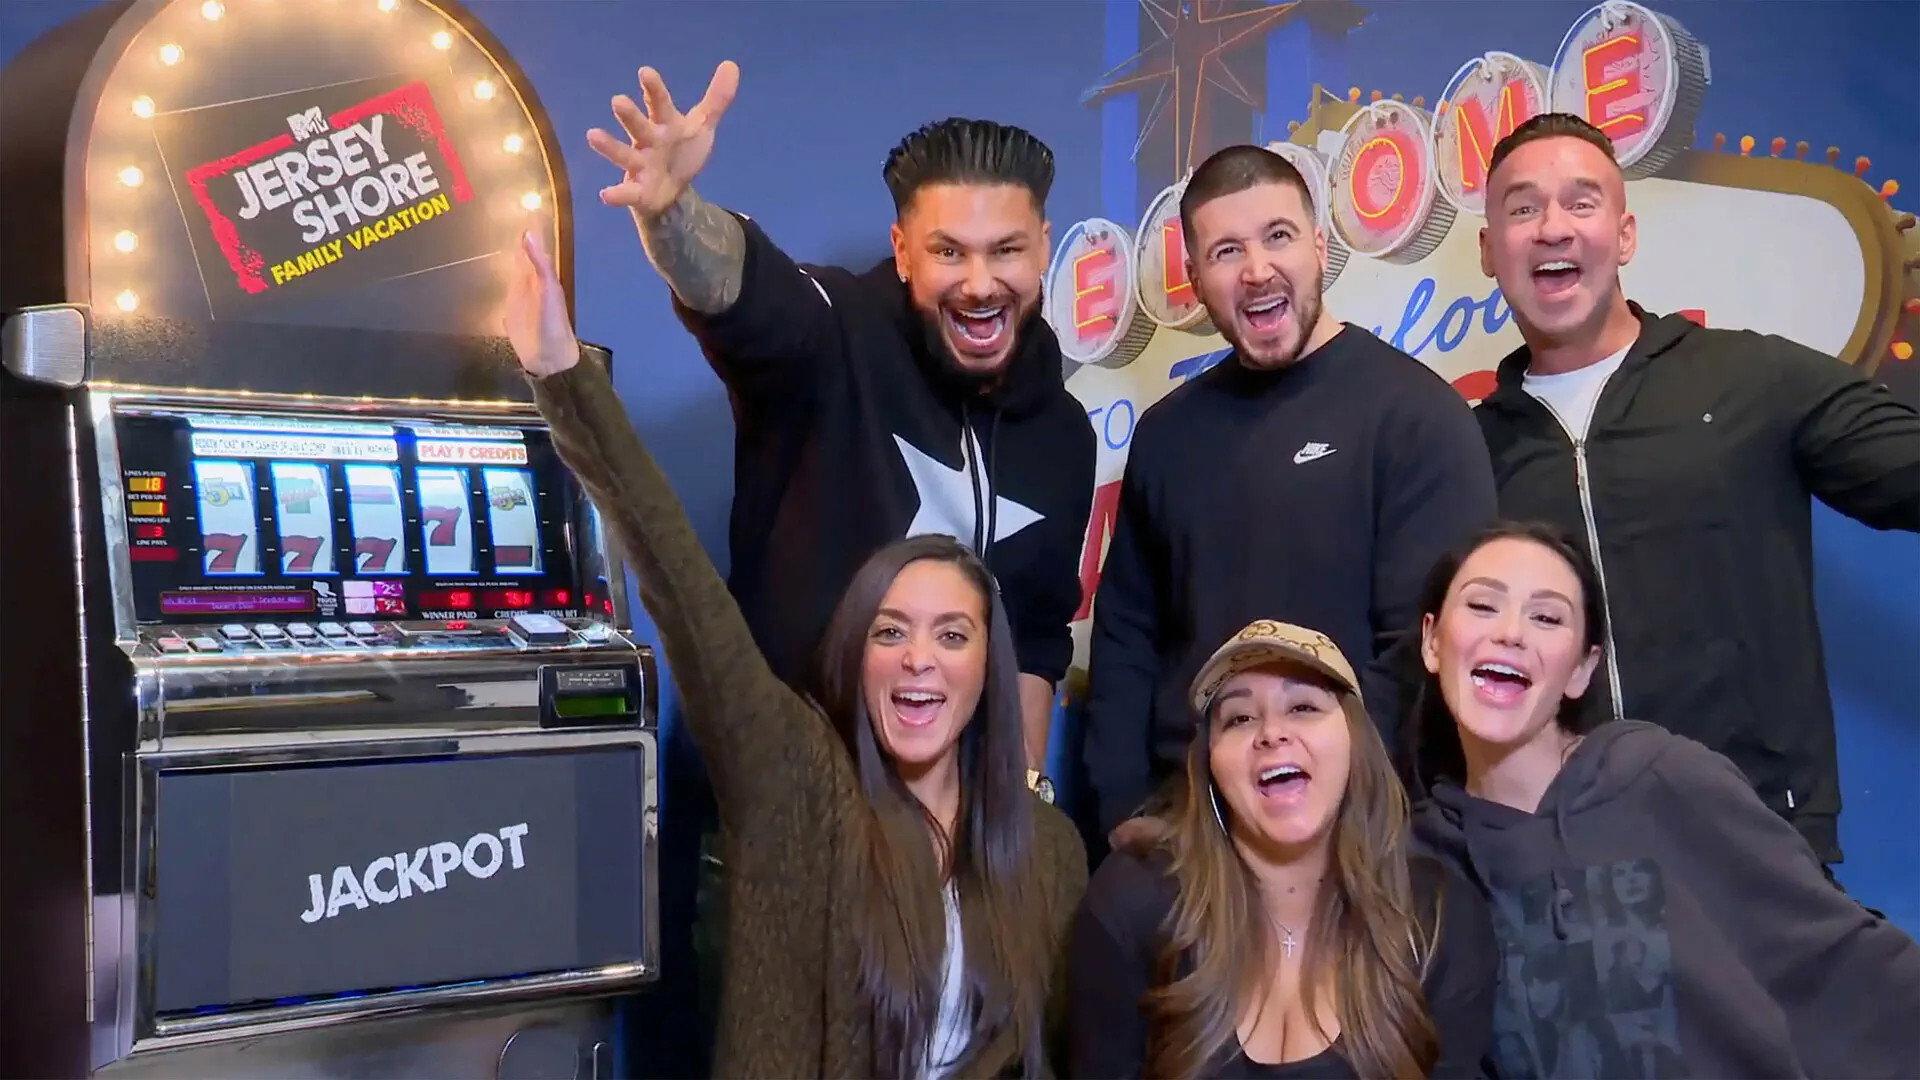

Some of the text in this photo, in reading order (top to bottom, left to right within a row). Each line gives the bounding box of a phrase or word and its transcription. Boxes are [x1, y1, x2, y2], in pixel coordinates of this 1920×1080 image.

[287, 106, 329, 142] MTV
[233, 114, 390, 219] JERSEY
[293, 152, 440, 243] SHORE
[271, 194, 451, 286] FAMILY VACATION
[421, 444, 452, 458] PLAY
[469, 446, 525, 460] CREDITS
[146, 477, 162, 492] 18
[422, 506, 462, 546] 7
[203, 533, 248, 572] 7
[280, 535, 325, 572] 7
[355, 537, 397, 571] 7
[421, 611, 477, 620] WINNER PAID
[300, 823, 529, 923] JACKPOT
